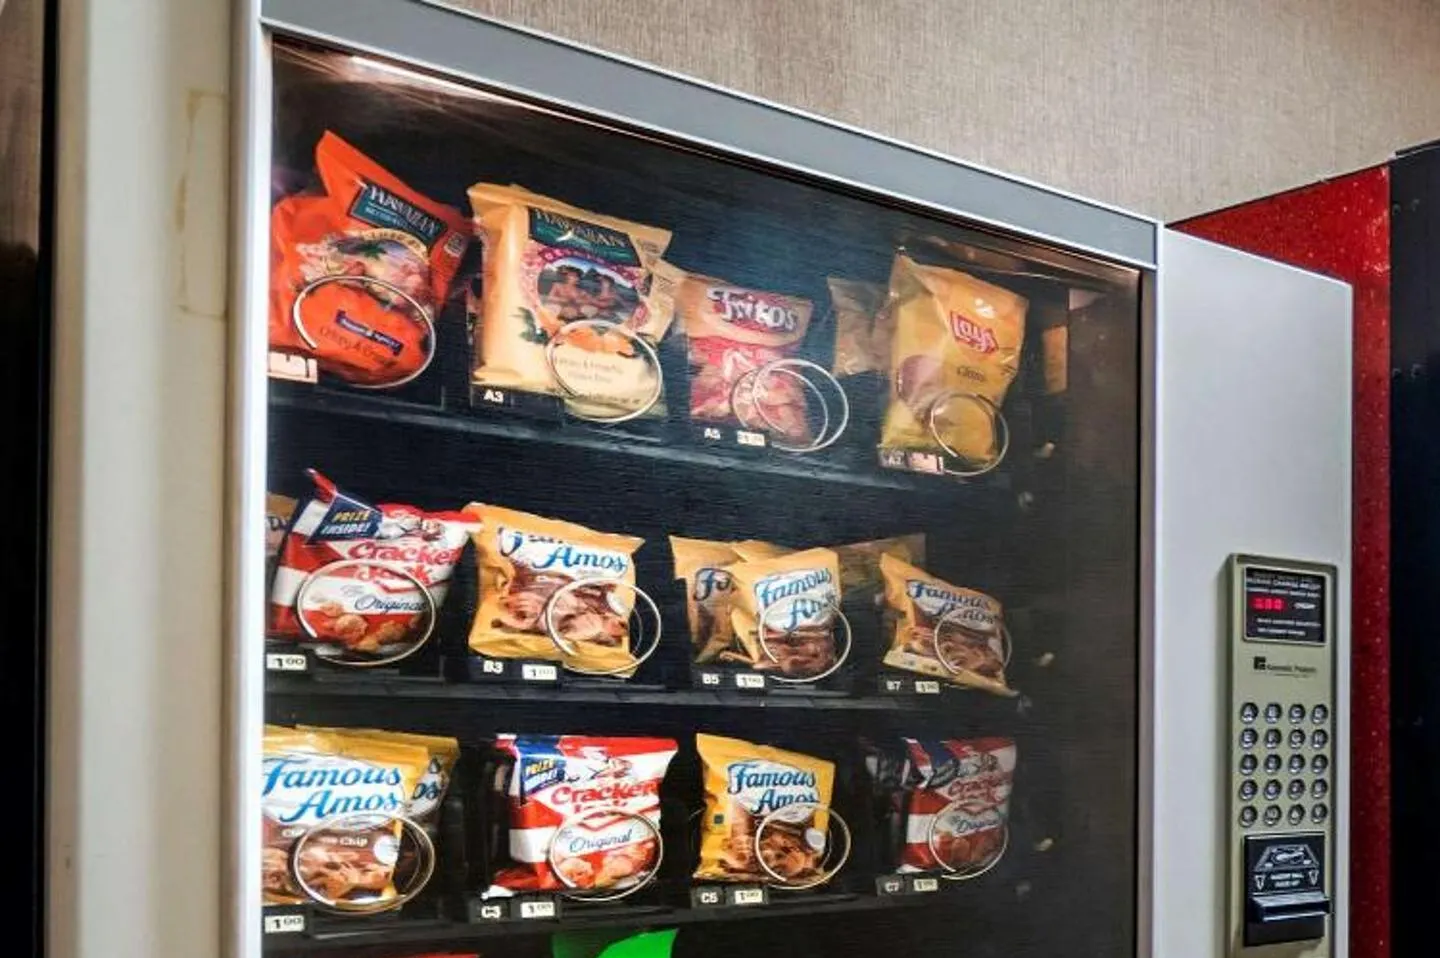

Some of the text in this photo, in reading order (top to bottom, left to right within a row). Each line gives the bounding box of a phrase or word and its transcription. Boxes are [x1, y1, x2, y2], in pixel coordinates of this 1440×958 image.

[705, 287, 798, 330] Fritos
[483, 389, 505, 404] A3
[531, 545, 627, 573] Amos
[754, 567, 833, 609] Famous
[262, 757, 402, 797] Famous
[727, 763, 817, 795] Famous
[279, 789, 397, 823] Amos
